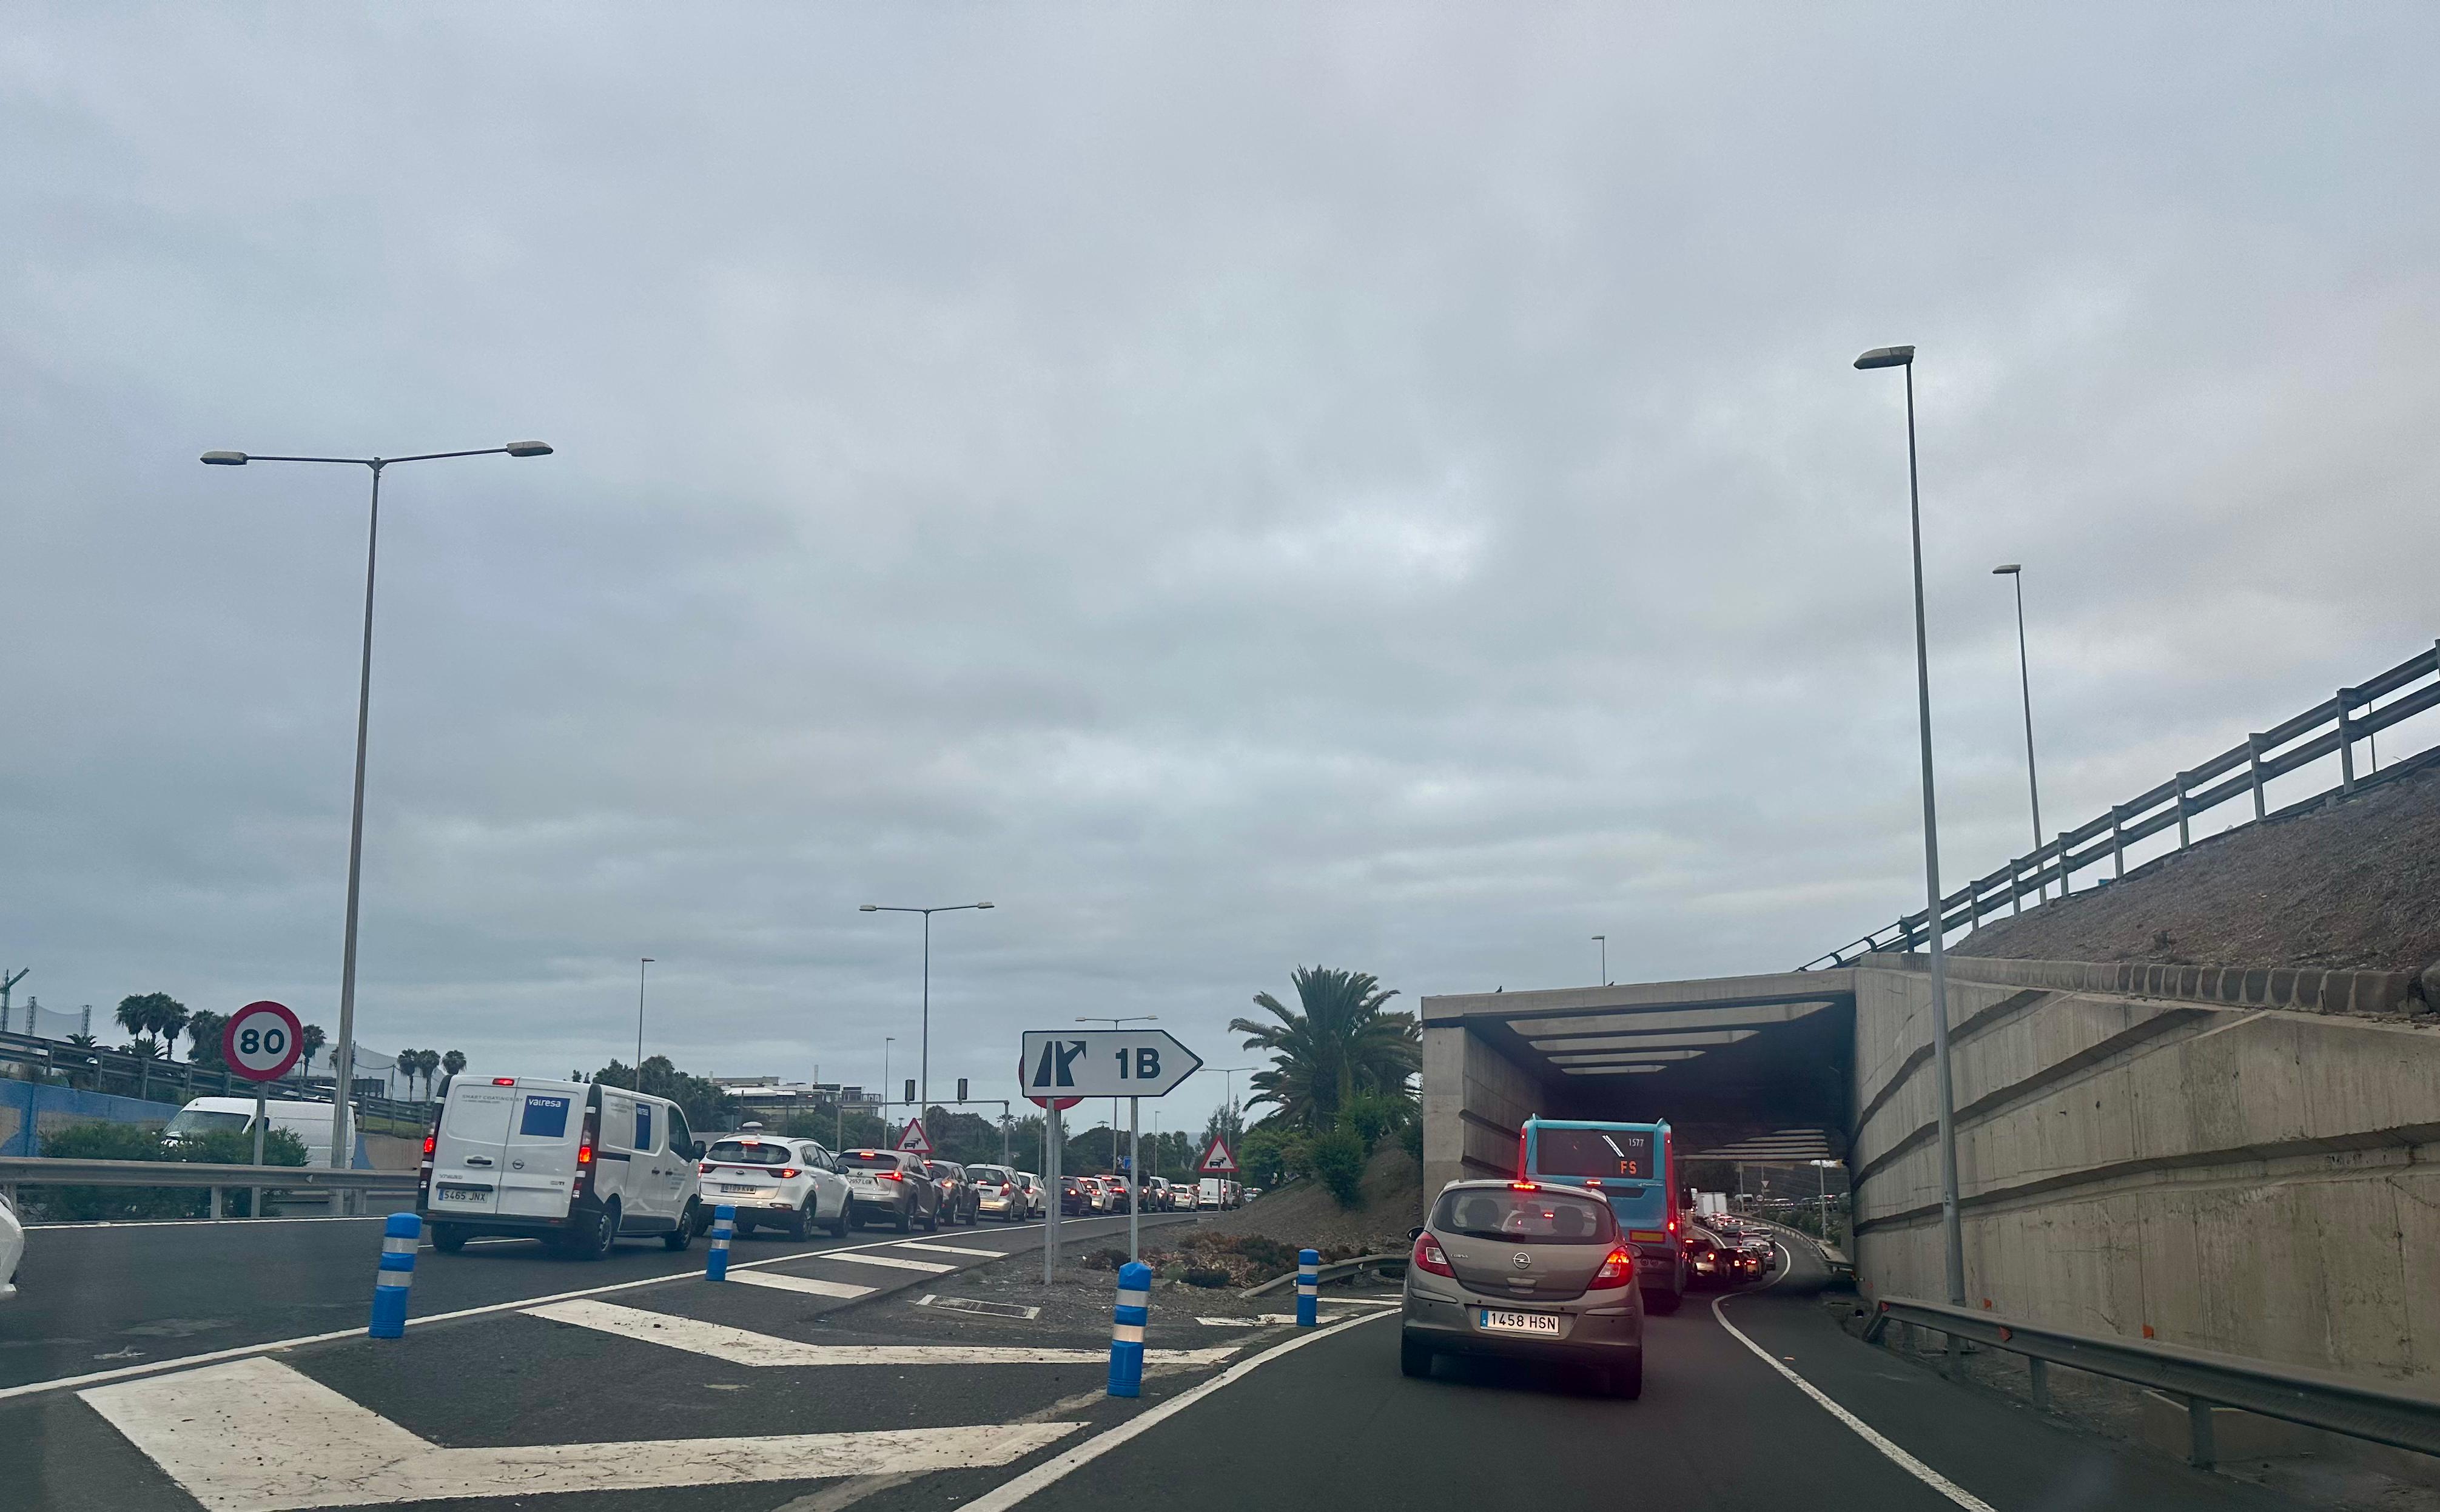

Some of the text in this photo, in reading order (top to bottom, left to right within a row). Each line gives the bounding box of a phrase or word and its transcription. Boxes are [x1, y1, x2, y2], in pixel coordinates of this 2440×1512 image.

[240, 1029, 284, 1054] 80
[1115, 1047, 1161, 1079] 1B
[1628, 1138, 1644, 1147] 1577
[469, 1192, 486, 1201] JNX
[1492, 1312, 1555, 1329] 1458 HSN
